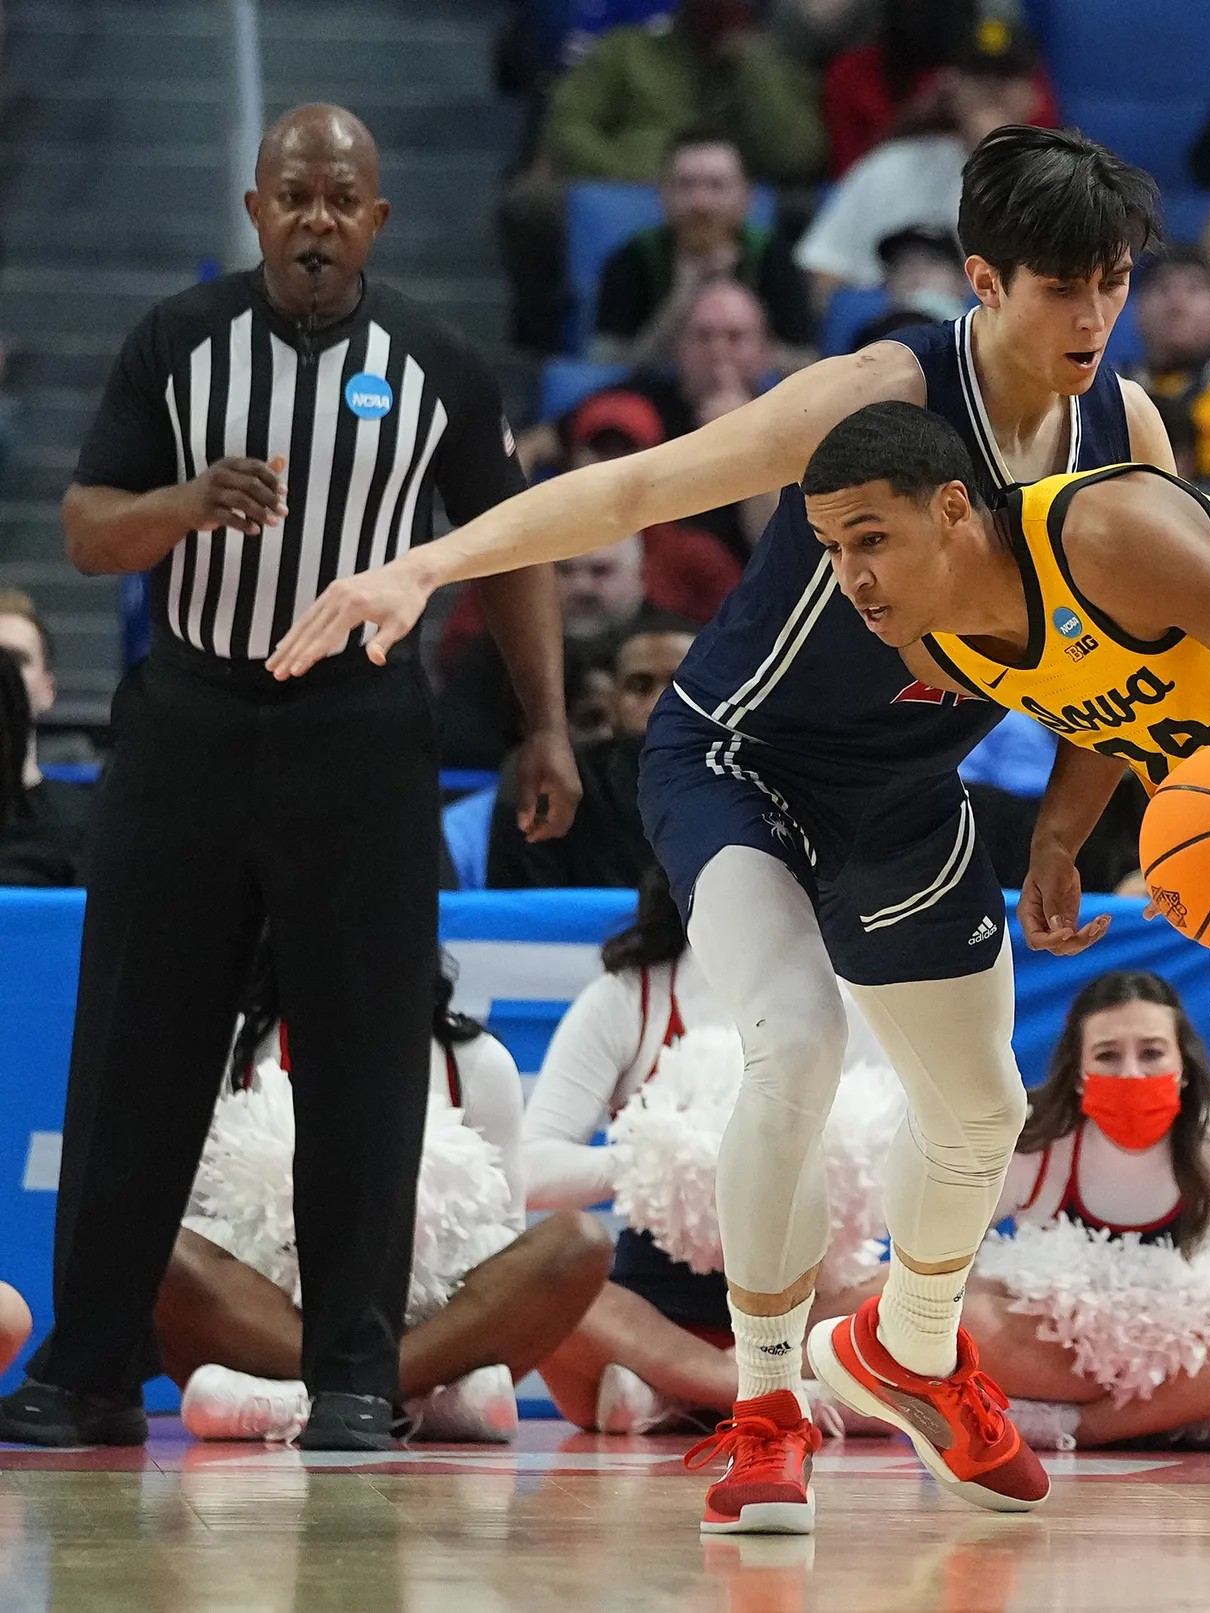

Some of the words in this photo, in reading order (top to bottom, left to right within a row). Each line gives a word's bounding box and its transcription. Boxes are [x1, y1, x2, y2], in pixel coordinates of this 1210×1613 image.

[352, 391, 390, 410] NCAA
[1060, 616, 1080, 635] NCAA
[1021, 665, 1175, 734] Iowa
[968, 924, 998, 946] adidas
